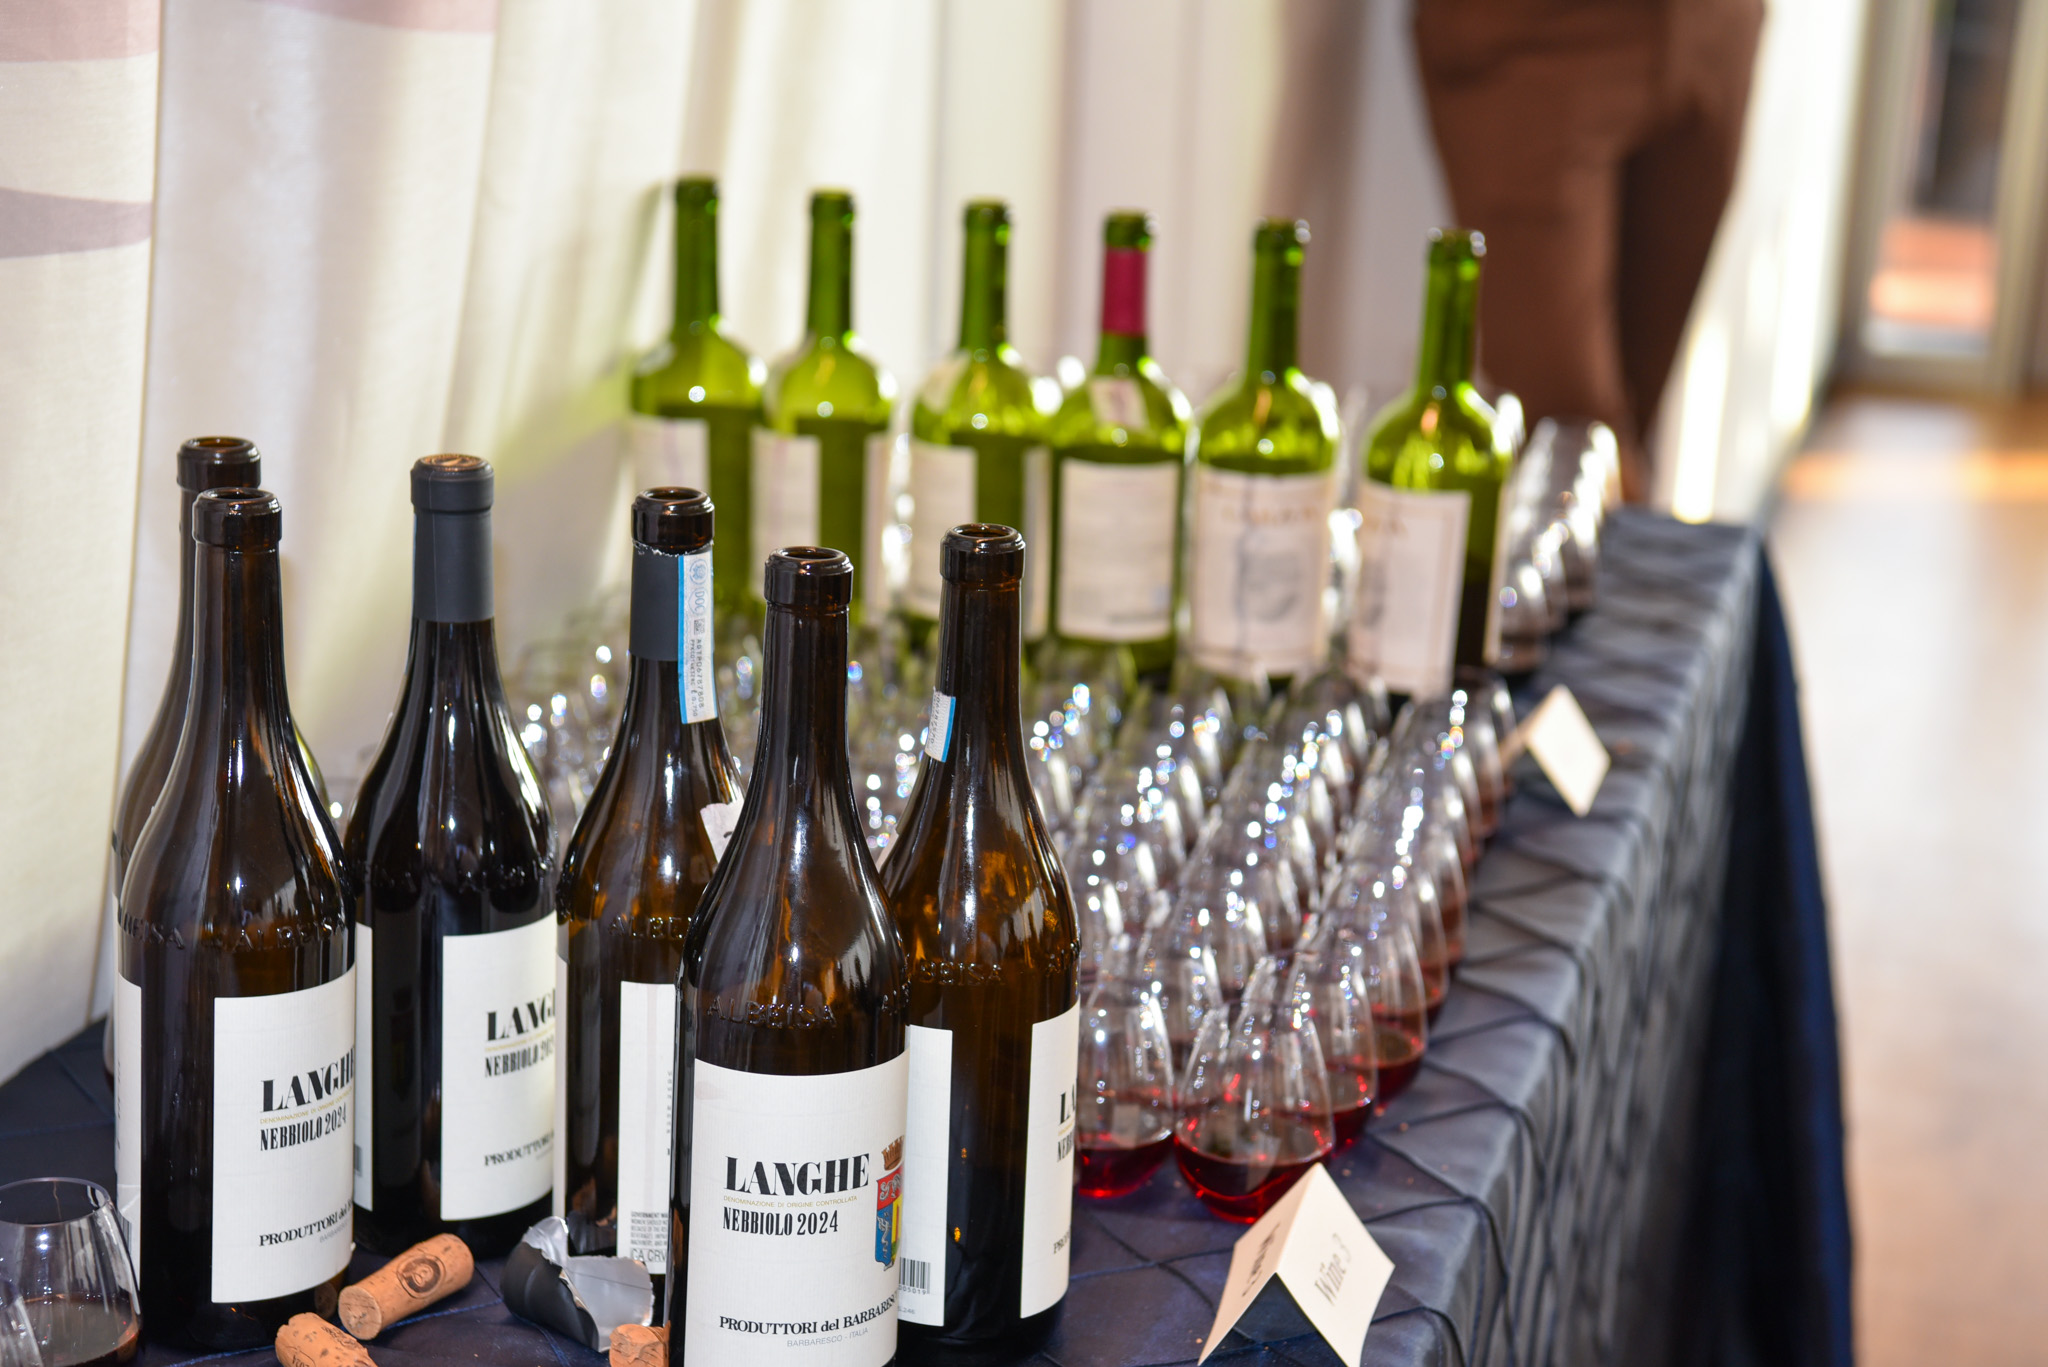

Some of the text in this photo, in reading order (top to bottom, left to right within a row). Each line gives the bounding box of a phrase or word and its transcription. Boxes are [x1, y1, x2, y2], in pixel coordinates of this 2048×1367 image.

[694, 590, 705, 614] DOC
[706, 995, 838, 1030] ALBEISA
[485, 1044, 538, 1078] NEBBIOLO
[260, 1101, 346, 1152] NEBBIOLO 2024
[724, 1153, 870, 1197] LANGHE
[723, 1195, 774, 1208] DENOMINAZIONE
[815, 1195, 858, 1207] CONTROLLATA
[258, 1212, 338, 1247] PRODUTTORI
[722, 1206, 839, 1236] NEBBIOLO 2024
[1315, 1261, 1347, 1306] Wine
[719, 1291, 898, 1335] PRODUTTORI del BARBARES
[786, 1333, 843, 1348] BARBARESCO
[849, 1327, 869, 1340] ITALIA
